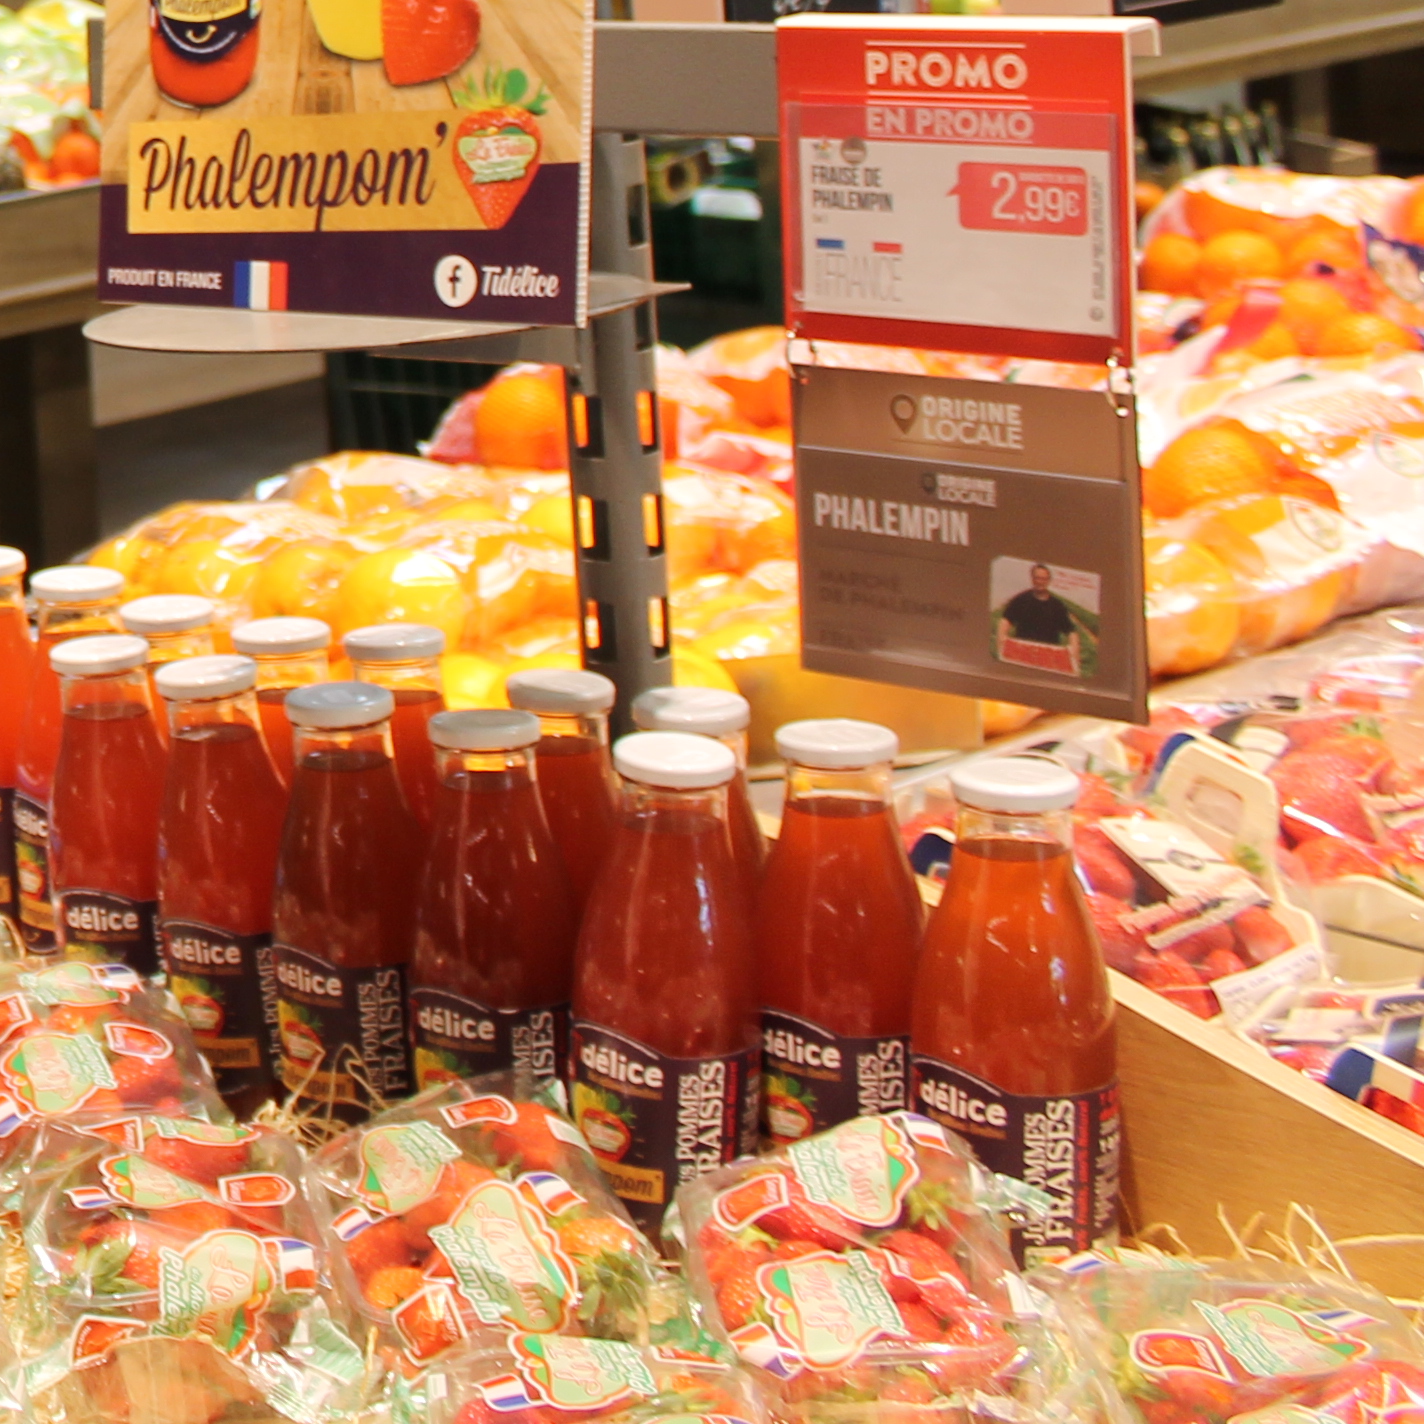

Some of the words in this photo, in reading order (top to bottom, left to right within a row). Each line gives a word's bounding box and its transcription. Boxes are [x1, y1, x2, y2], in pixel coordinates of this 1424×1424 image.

[864, 50, 1028, 89] PROMO
[866, 107, 907, 134] EN
[915, 109, 1035, 139] PROMO
[138, 120, 449, 232] Phalempom'
[811, 165, 860, 188] FRAISE
[864, 166, 882, 188] DE
[811, 188, 894, 214] PHALEMPIN
[990, 171, 1081, 224] 2,99€
[107, 267, 156, 288] PRODUIT
[157, 269, 174, 289] EN
[175, 271, 223, 291] FRANCE
[480, 263, 561, 299] Tidélice
[920, 394, 1023, 426] ORIGINE
[923, 419, 1025, 451] LOCALE
[813, 491, 971, 547] PHALEMPIN
[376, 968, 408, 1091] FRAISES
[511, 1025, 531, 1076] MMES
[530, 1011, 556, 1077] ISES
[856, 1053, 880, 1116] MMES
[877, 1039, 905, 1110] ISES
[675, 1073, 700, 1161] POMMES
[697, 1060, 727, 1175] RAISES
[1022, 1112, 1048, 1190] OMMES
[1045, 1098, 1076, 1240] FRAISES
